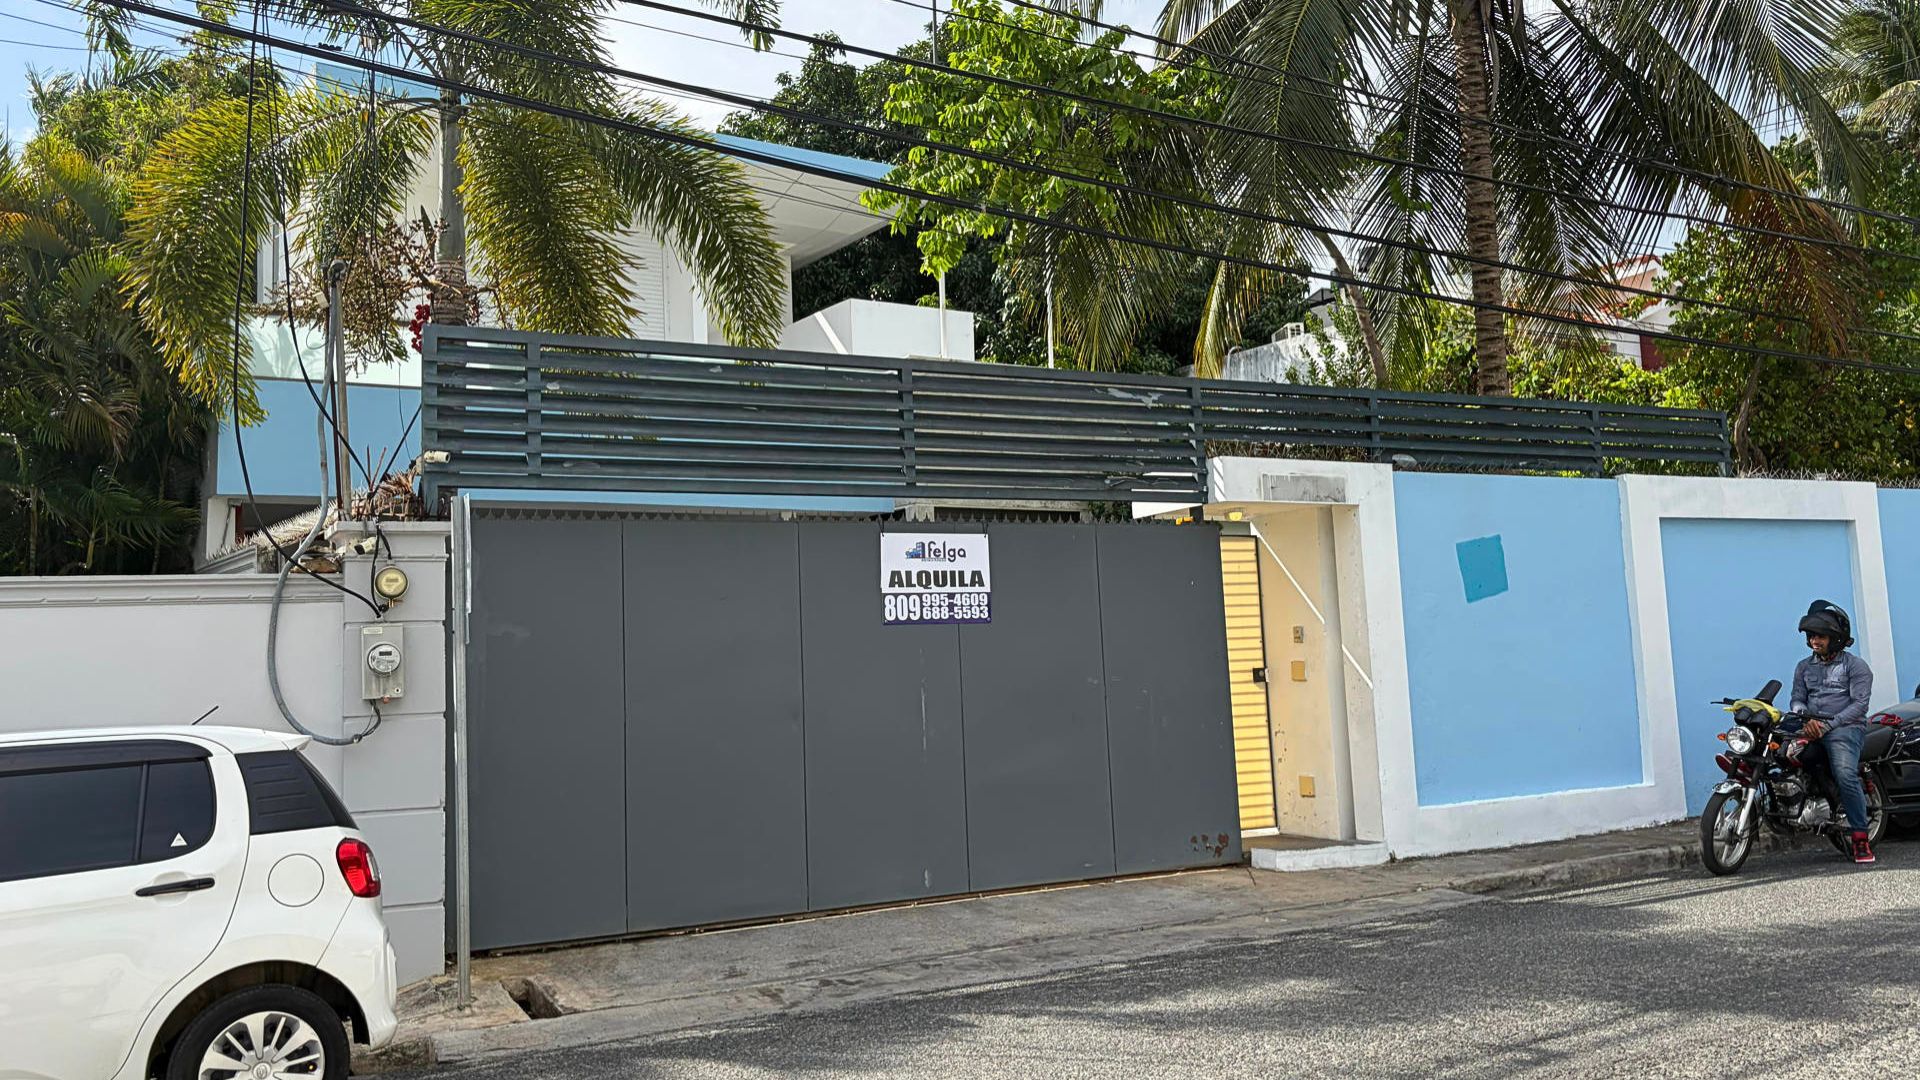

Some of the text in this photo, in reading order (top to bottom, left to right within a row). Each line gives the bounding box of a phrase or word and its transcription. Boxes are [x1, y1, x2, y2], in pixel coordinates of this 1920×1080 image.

[928, 541, 966, 562] felga
[889, 570, 985, 589] ALQUILA
[884, 593, 988, 621] 809 995-4609
[922, 606, 989, 619] 688-5593
